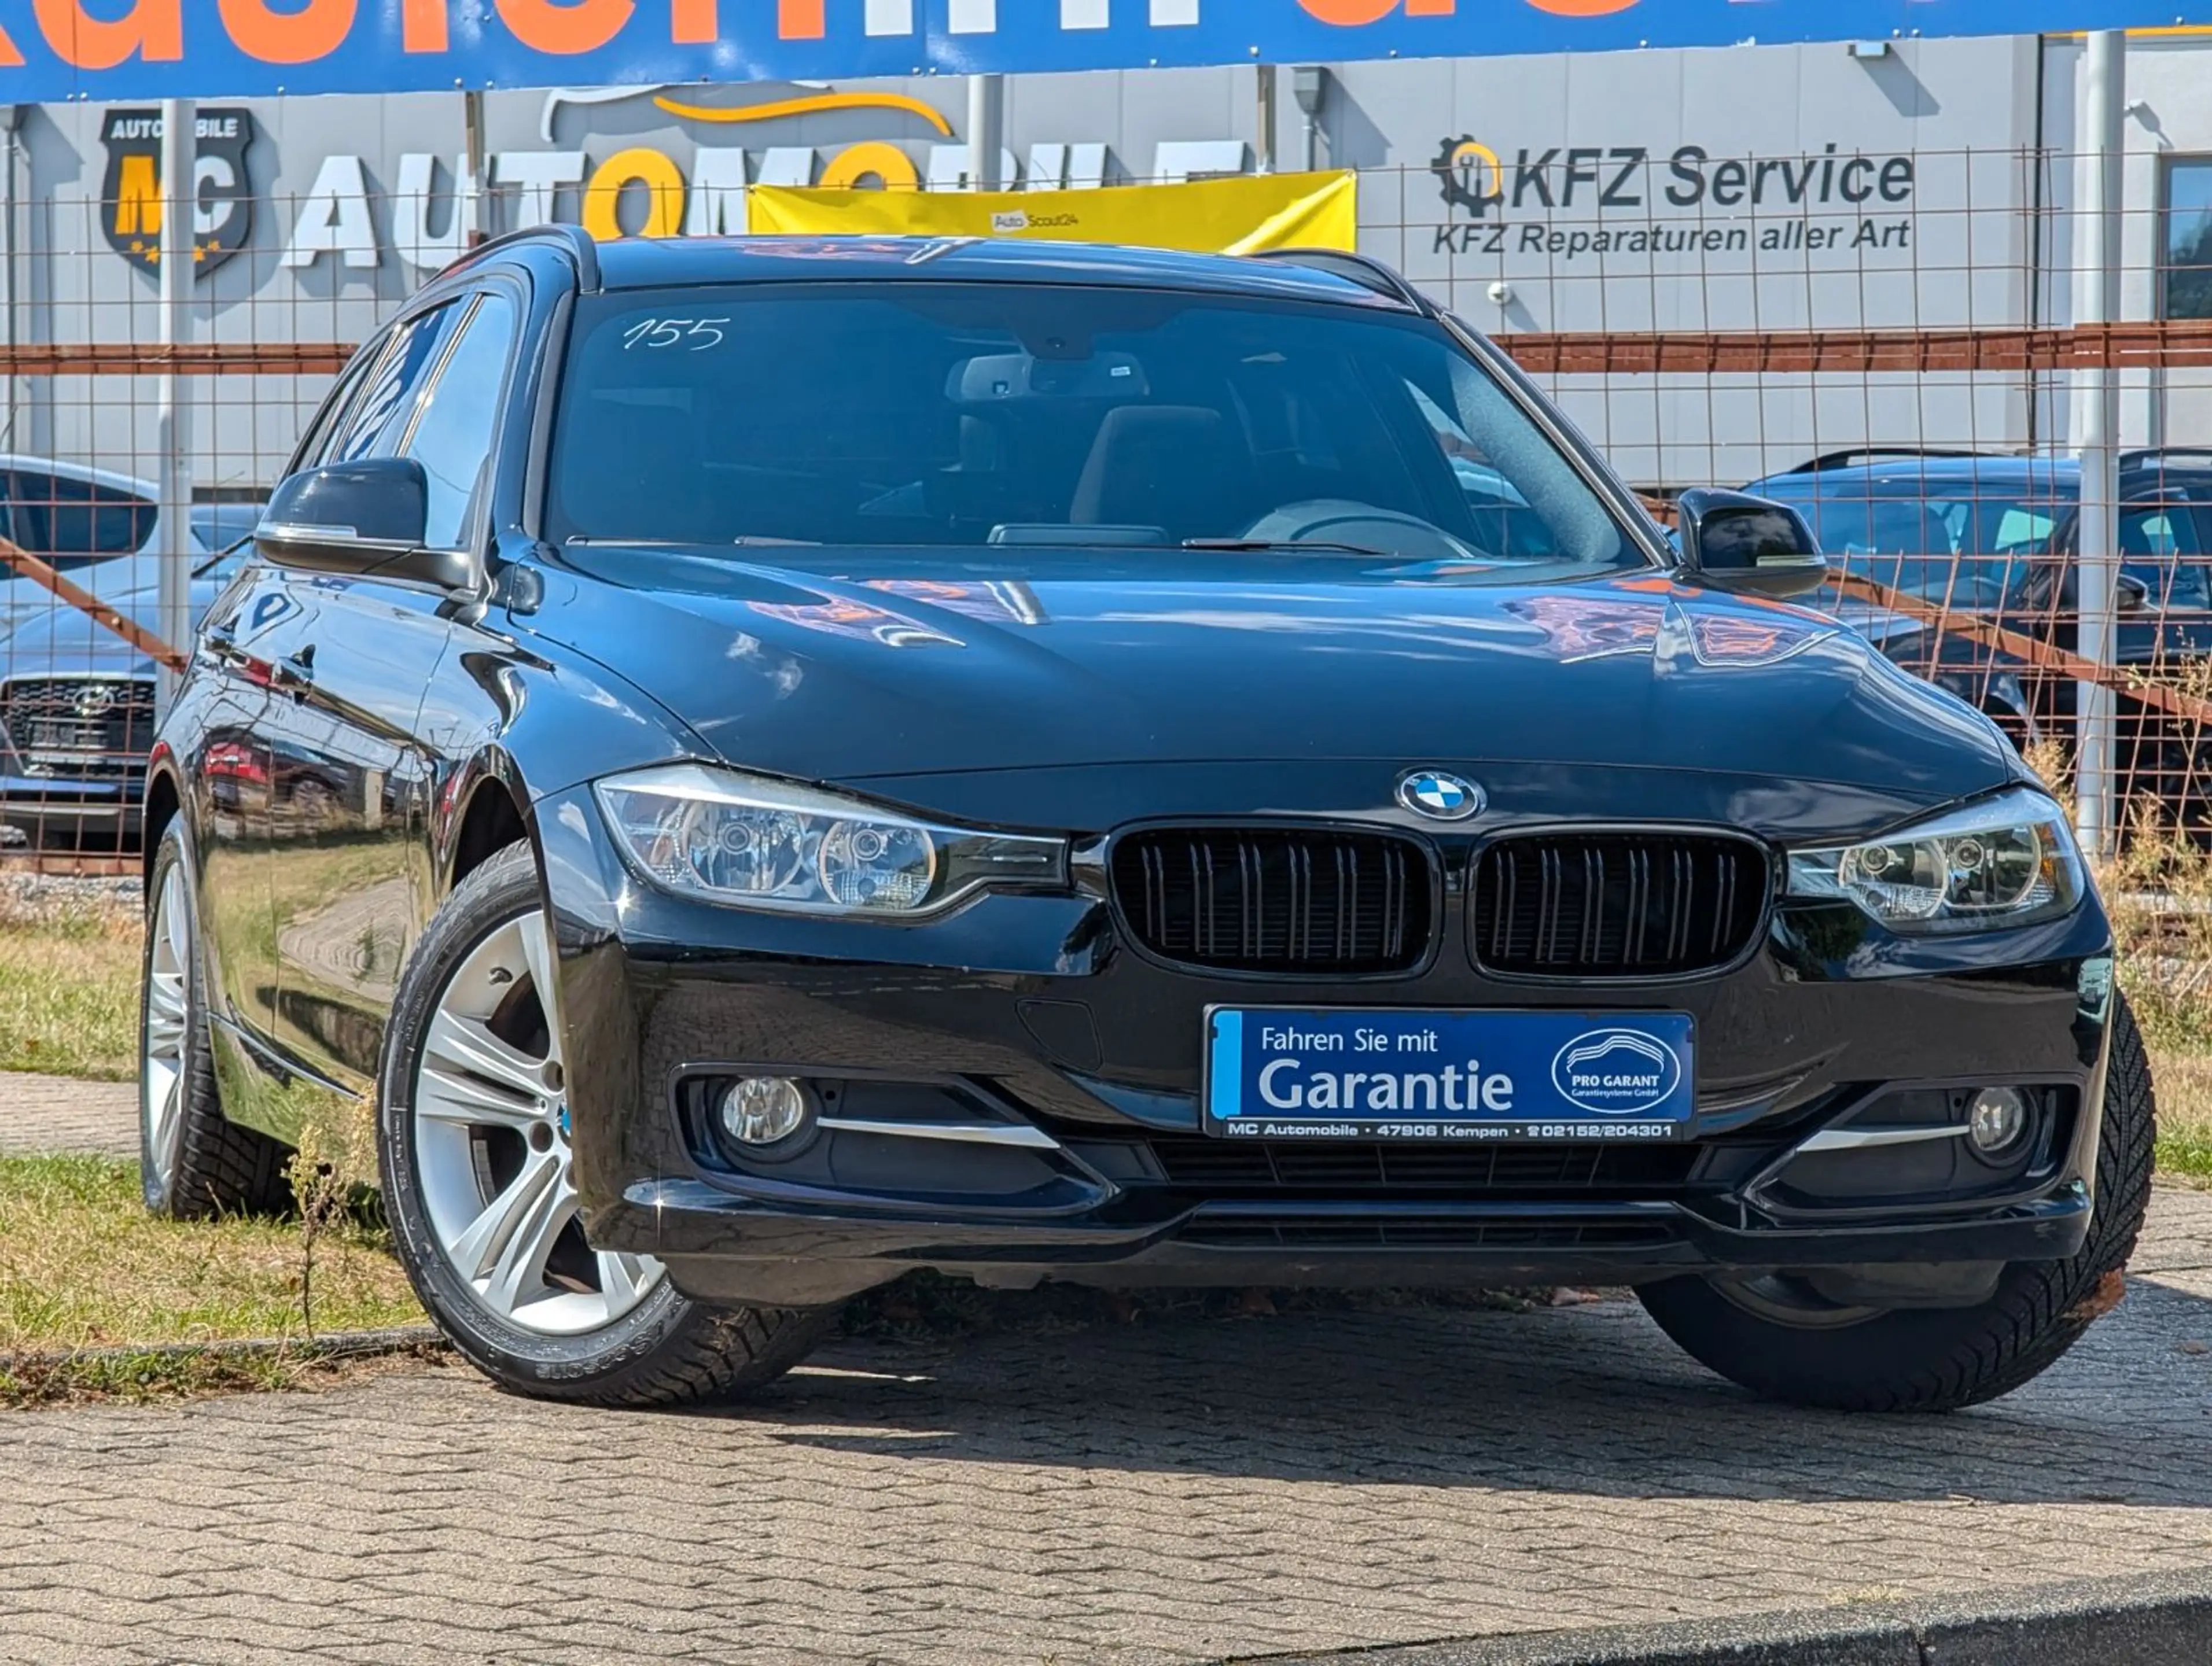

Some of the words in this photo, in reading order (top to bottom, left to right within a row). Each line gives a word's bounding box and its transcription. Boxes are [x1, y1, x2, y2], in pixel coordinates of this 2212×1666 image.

[111, 118, 238, 139] AUTOBILE
[1512, 147, 1647, 208] KFZ
[1665, 142, 1914, 207] Service
[1432, 223, 1507, 254] KFZ
[1519, 223, 1746, 259] Reparaturen
[1760, 220, 1842, 250] aller
[1849, 218, 1911, 249] Art
[623, 318, 731, 351] 155
[1261, 1027, 1344, 1052] Fahren
[1355, 1029, 1388, 1052] Sie
[1397, 1030, 1438, 1052] mit
[1258, 1058, 1514, 1111] Garantie
[1571, 1075, 1600, 1087] PRO
[1603, 1075, 1660, 1087] GARANT
[1227, 1123, 1259, 1135] MC
[1264, 1123, 1359, 1136] Automobile
[1443, 1126, 1509, 1139] Kempen
